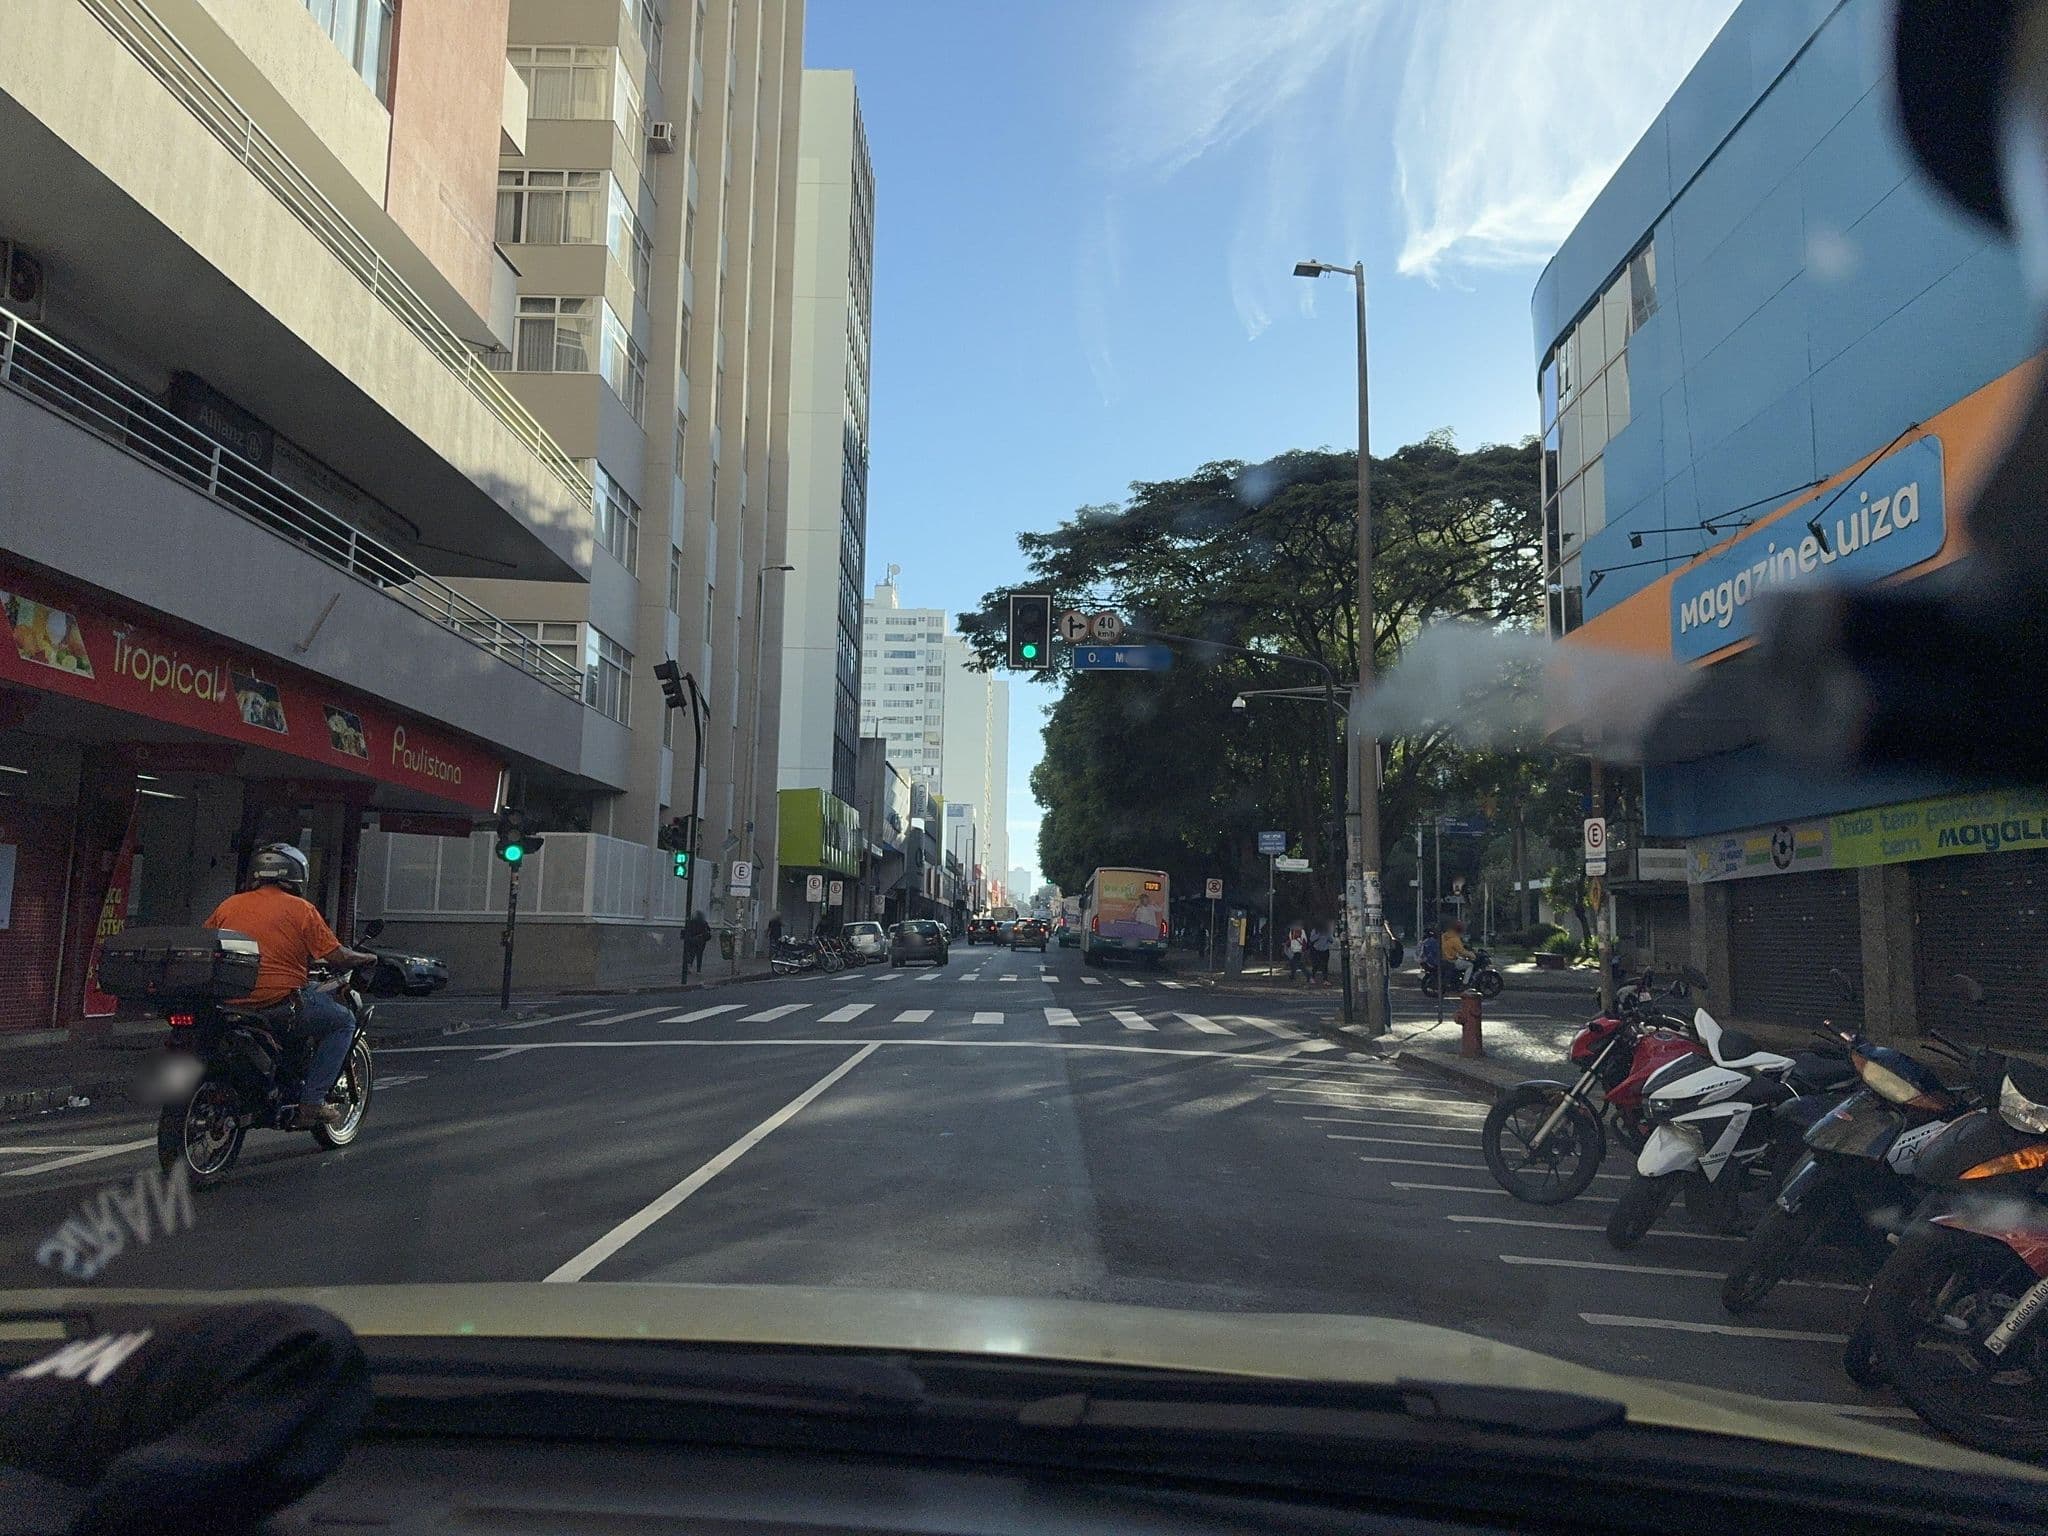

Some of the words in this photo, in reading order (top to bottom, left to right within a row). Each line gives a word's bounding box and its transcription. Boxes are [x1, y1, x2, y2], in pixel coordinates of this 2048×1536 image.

[1099, 616, 1114, 629] 40
[113, 629, 217, 701] Tropical
[392, 725, 461, 785] Paulistana
[1592, 828, 1598, 842] E
[738, 866, 745, 876] E
[2005, 1298, 2038, 1332] Cardoso
[2032, 1281, 2048, 1302] Mot
